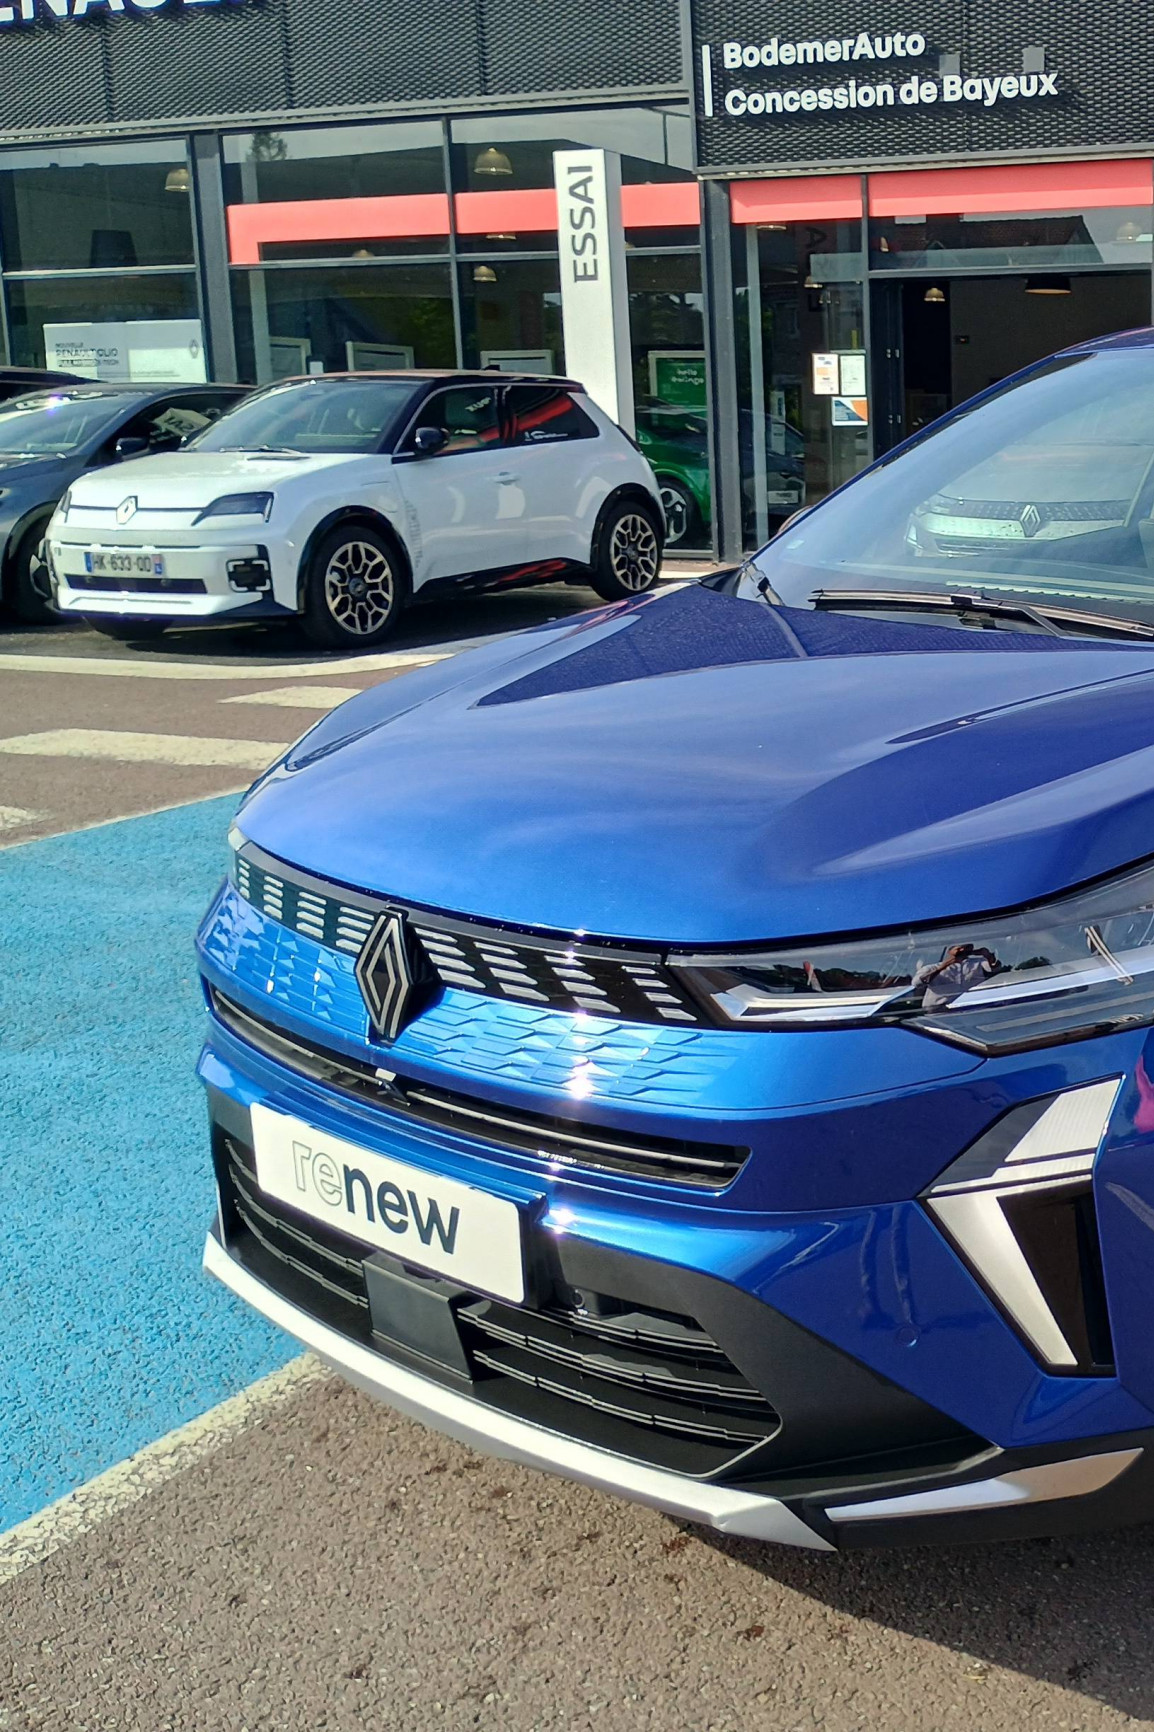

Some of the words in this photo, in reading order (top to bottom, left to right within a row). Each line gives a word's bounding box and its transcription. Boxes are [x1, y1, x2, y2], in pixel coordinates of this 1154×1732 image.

[723, 32, 926, 69] BodemerAuto
[724, 80, 895, 116] Concession
[899, 75, 938, 104] de
[943, 73, 1059, 107] Bayeux
[567, 165, 599, 283] ESSAI
[292, 1140, 460, 1255] renew
